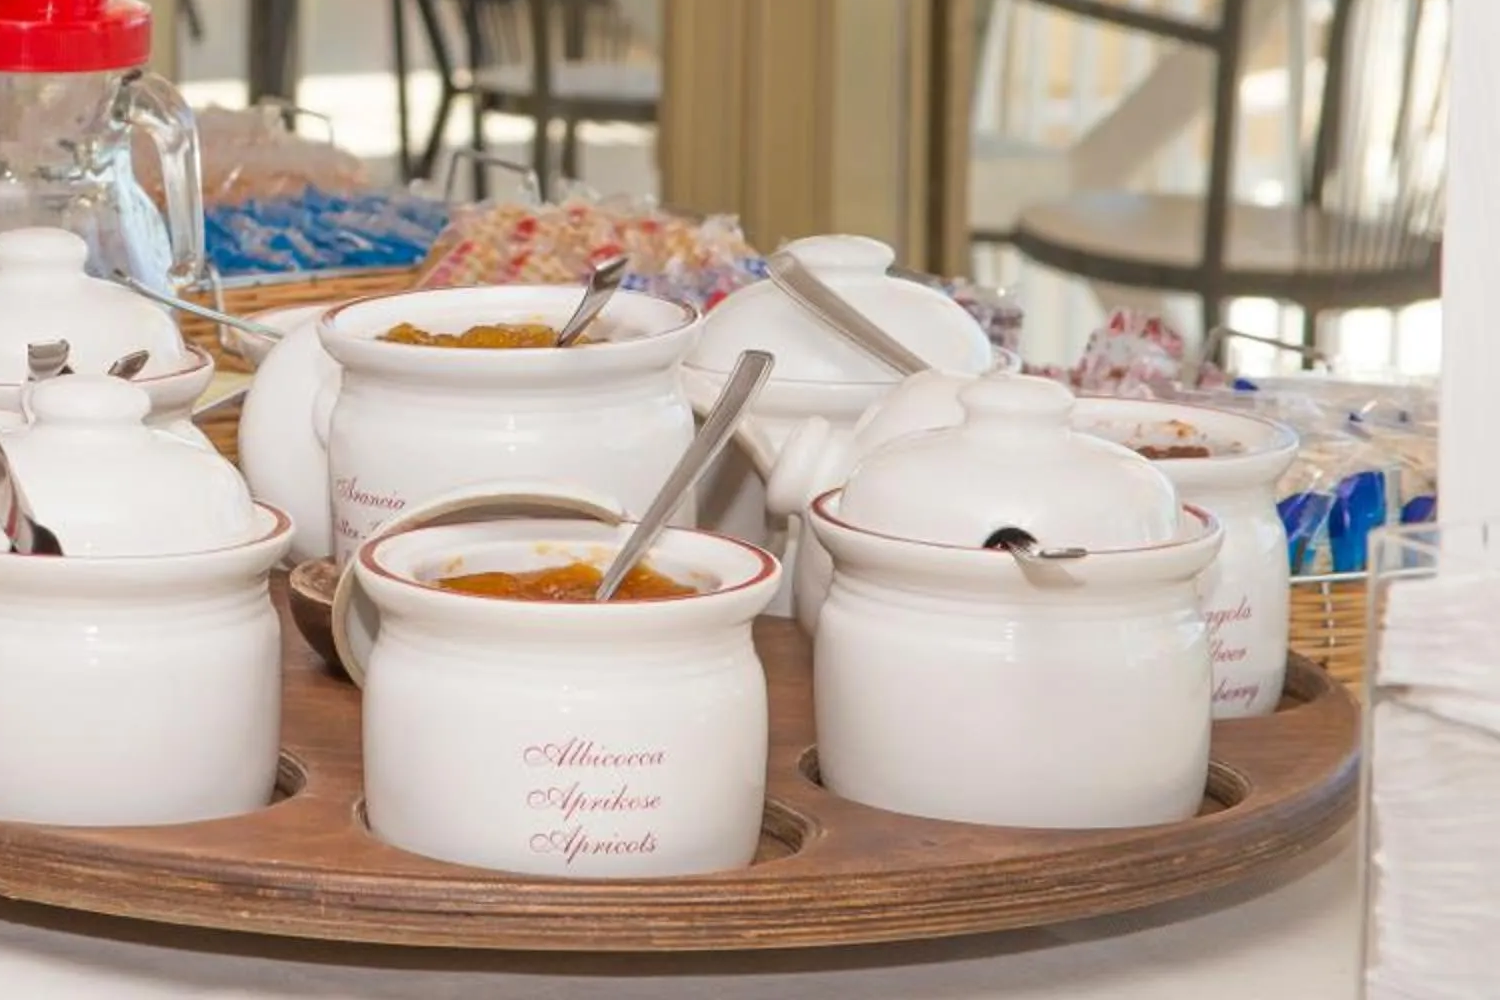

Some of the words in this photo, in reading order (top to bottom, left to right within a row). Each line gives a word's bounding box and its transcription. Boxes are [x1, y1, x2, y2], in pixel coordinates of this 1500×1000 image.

[337, 476, 406, 510] Arancia
[523, 736, 665, 767] Albicocca
[527, 781, 662, 821] Aprikose
[529, 825, 658, 865] Apricots
